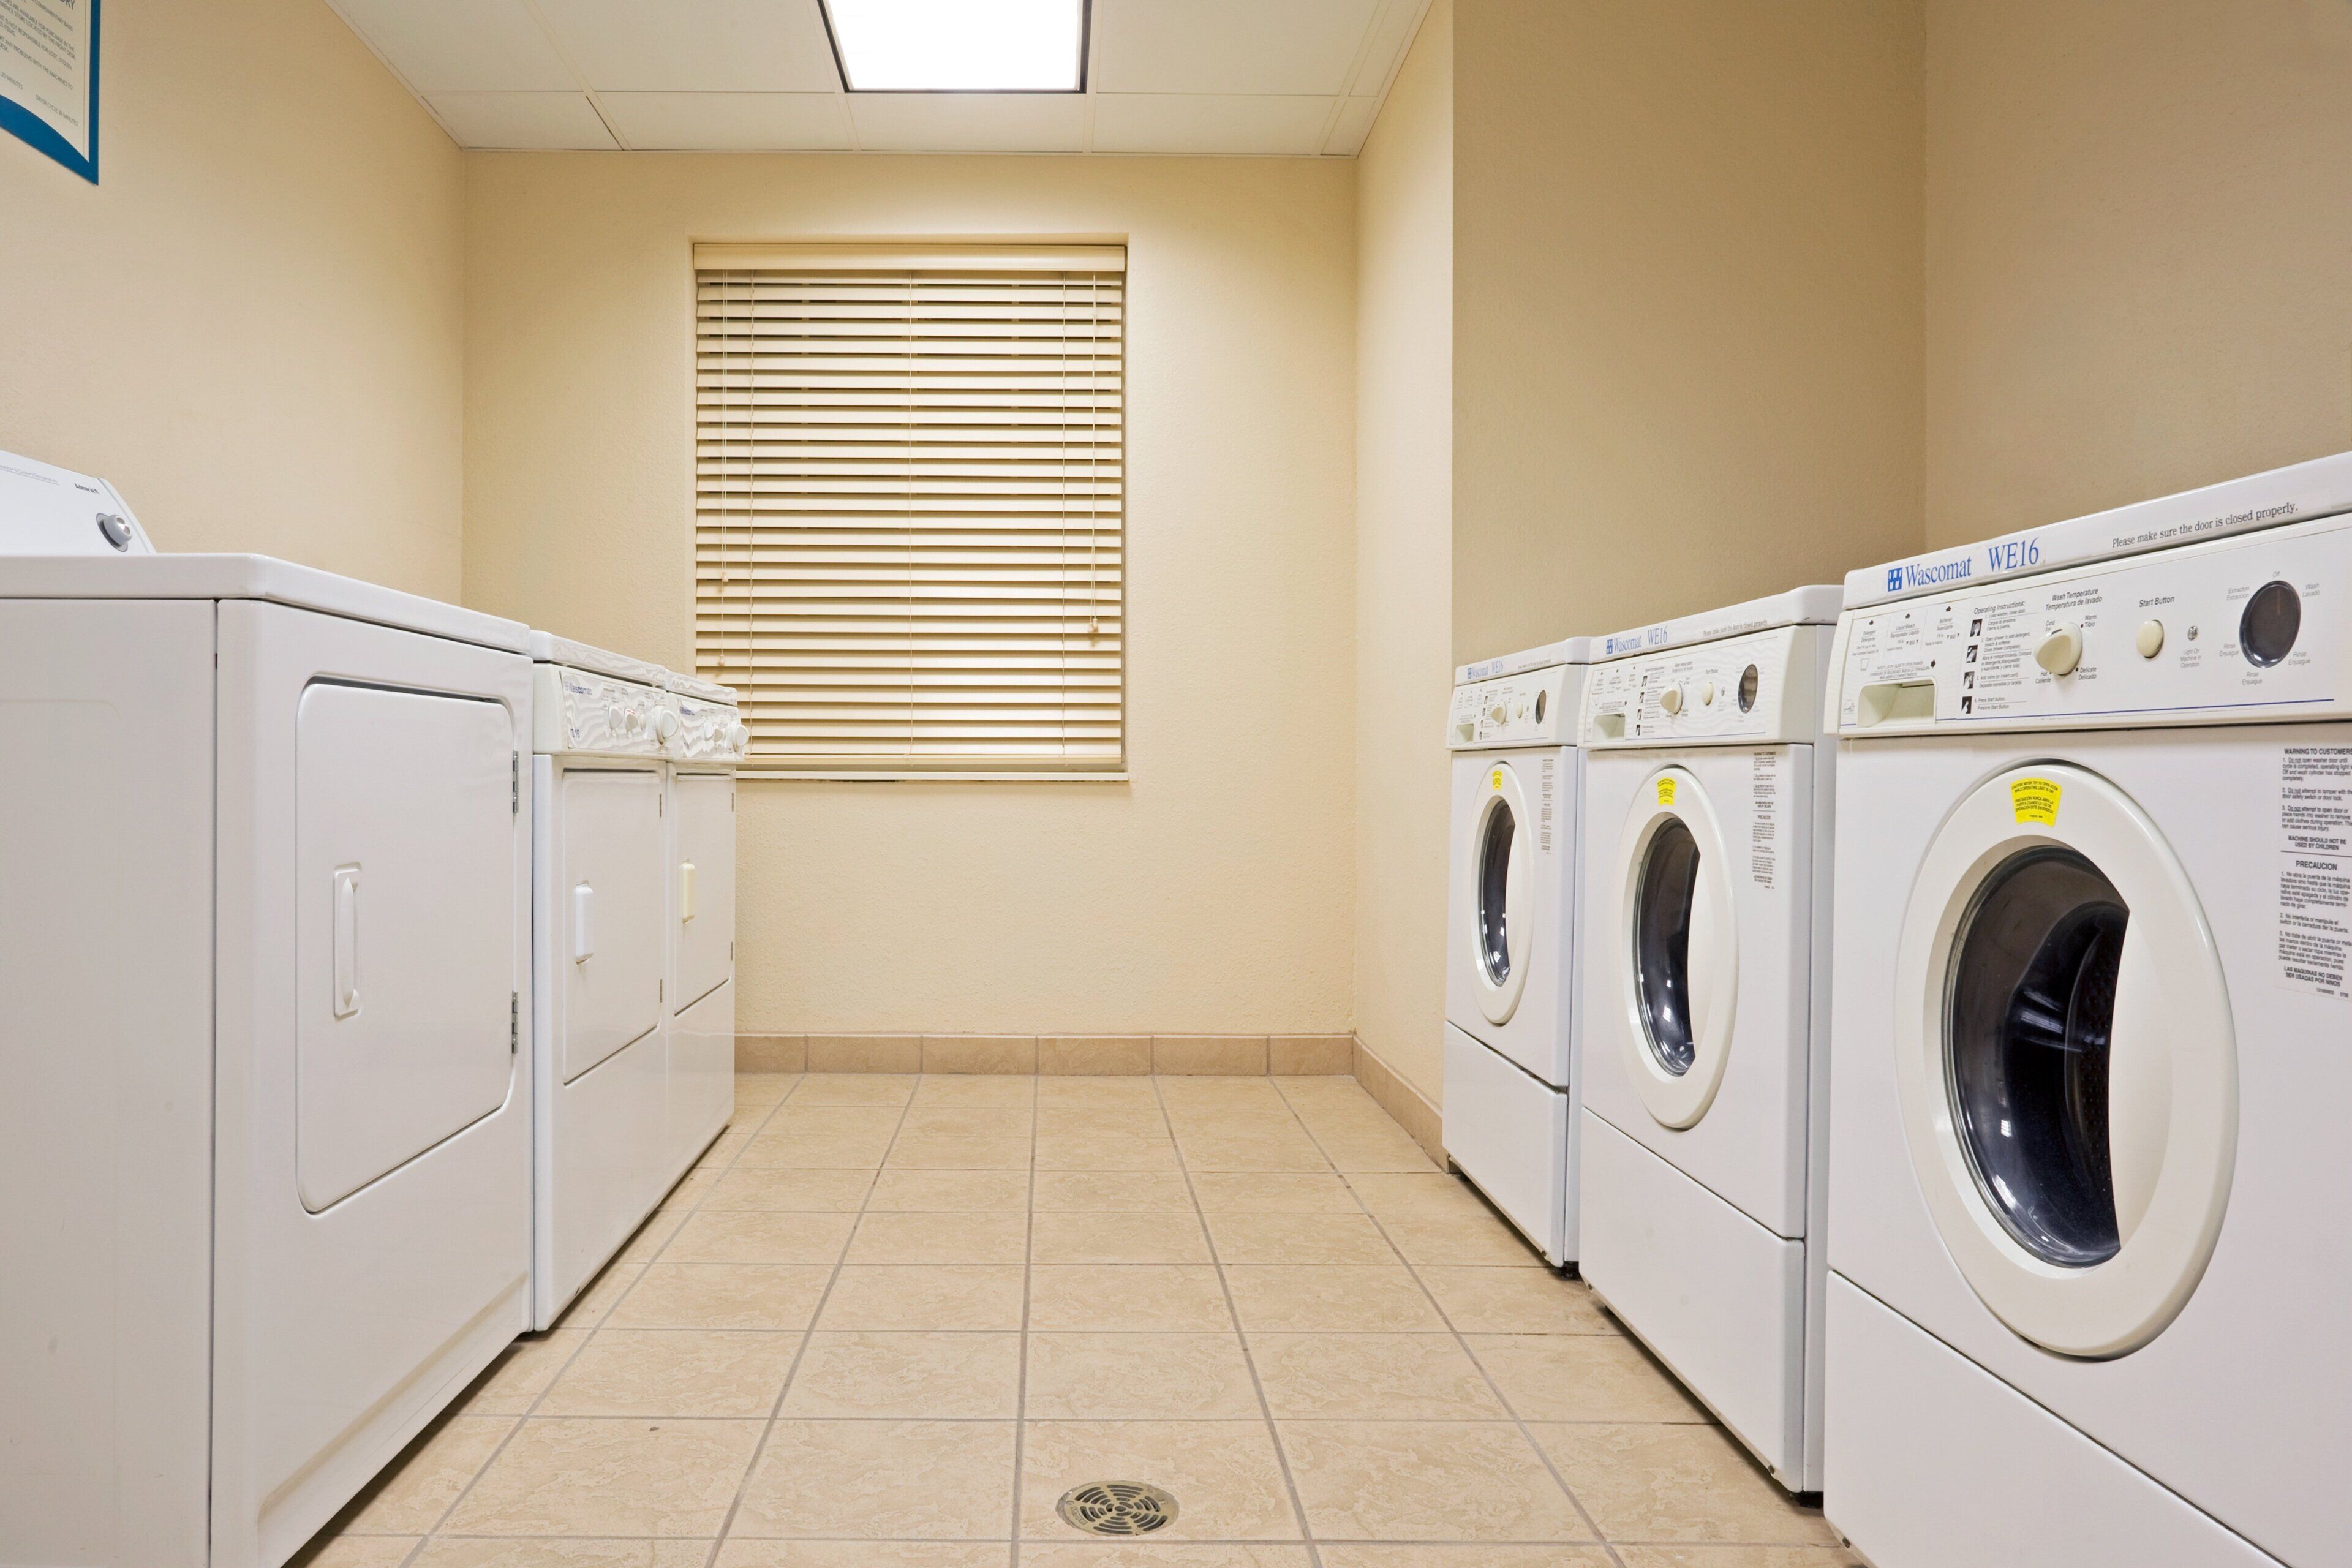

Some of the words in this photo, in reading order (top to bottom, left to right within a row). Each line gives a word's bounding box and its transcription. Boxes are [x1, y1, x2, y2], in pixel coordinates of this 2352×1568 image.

[2113, 538, 2135, 548] Please
[2137, 531, 2157, 543] make
[2159, 528, 2177, 538] sure
[2179, 524, 2193, 534] the
[2195, 521, 2213, 532] door
[2215, 517, 2223, 527] is
[2225, 510, 2253, 525] closed
[2256, 502, 2298, 521] properly.
[1905, 556, 1972, 587] Wascomat
[1988, 537, 2039, 572] WE16
[2067, 588, 2098, 598] Temperature
[2046, 601, 2076, 611] Temperatura
[2139, 599, 2154, 608] Start
[2155, 597, 2175, 605] Button
[1974, 606, 1996, 615] Operating
[1614, 636, 1642, 652] Wascomat
[1648, 625, 1668, 645] WE16
[2296, 860, 2337, 871] PRECAUCION
